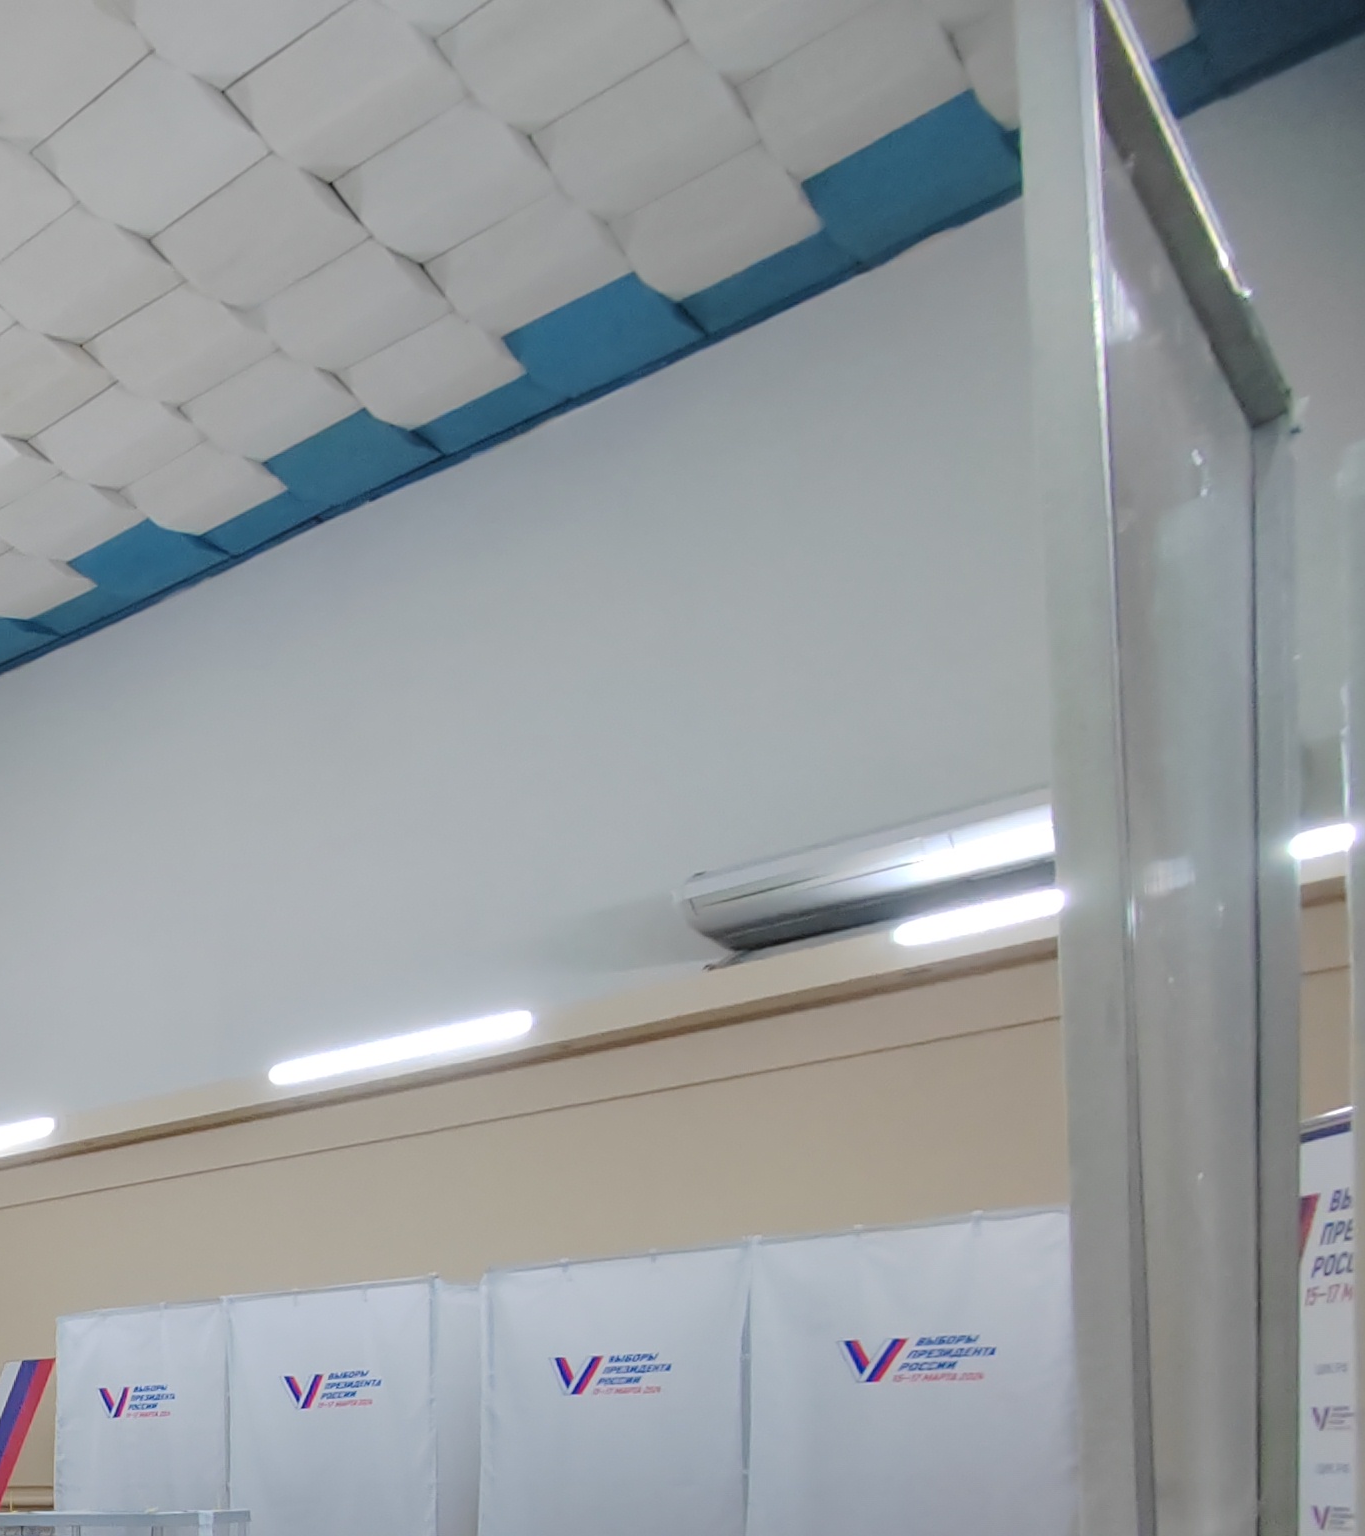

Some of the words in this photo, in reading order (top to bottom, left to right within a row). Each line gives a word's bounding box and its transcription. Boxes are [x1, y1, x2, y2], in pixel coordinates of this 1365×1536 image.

[915, 1334, 980, 1347] ВЫБОРЫ
[609, 1352, 659, 1363] ВЫБОРЫ
[906, 1347, 997, 1359] ПРЕЗИДЕНТА
[602, 1364, 672, 1374] ПРЕЗИДЕНТА
[898, 1361, 958, 1371] РОССИИ
[328, 1370, 370, 1380] ВЫБОРЫ
[324, 1379, 382, 1389] ПРЕЗИДЕНТА
[596, 1376, 642, 1385] РОССИИ
[320, 1390, 357, 1400] РОССИИ
